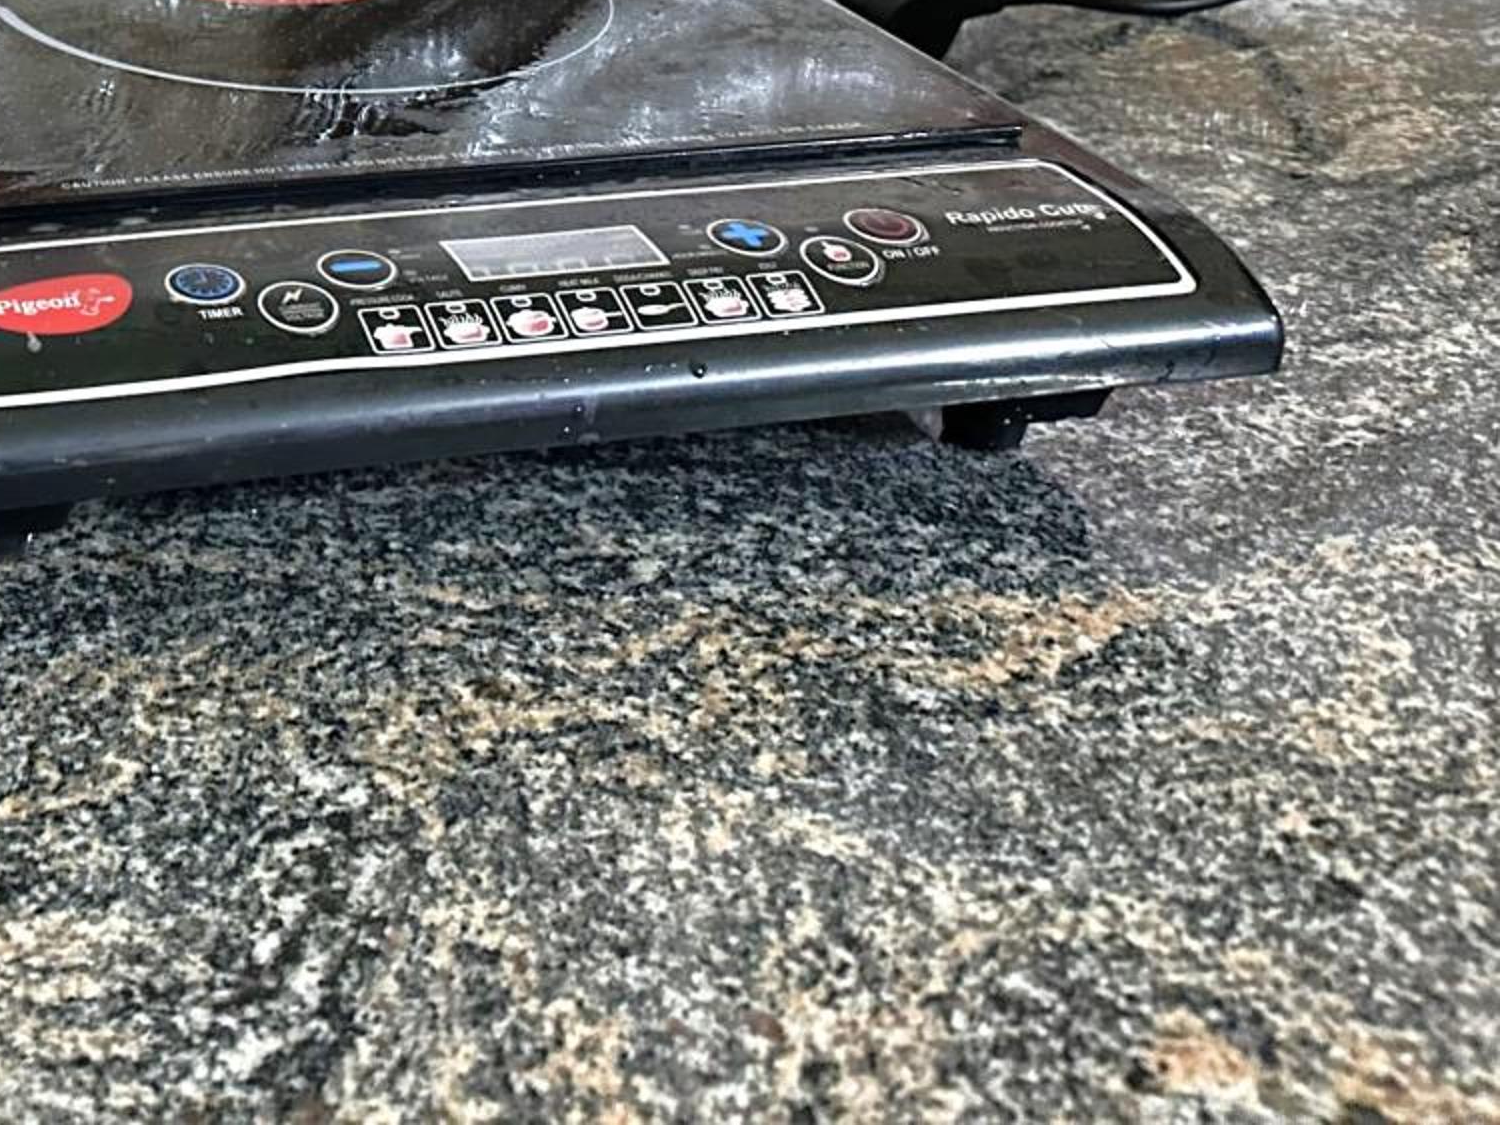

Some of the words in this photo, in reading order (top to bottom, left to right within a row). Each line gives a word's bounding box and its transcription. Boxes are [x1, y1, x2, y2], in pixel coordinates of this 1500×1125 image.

[945, 206, 1035, 225] Rapido
[882, 248, 906, 259] ON
[913, 245, 940, 257] OFF
[198, 306, 244, 321] TIMER
